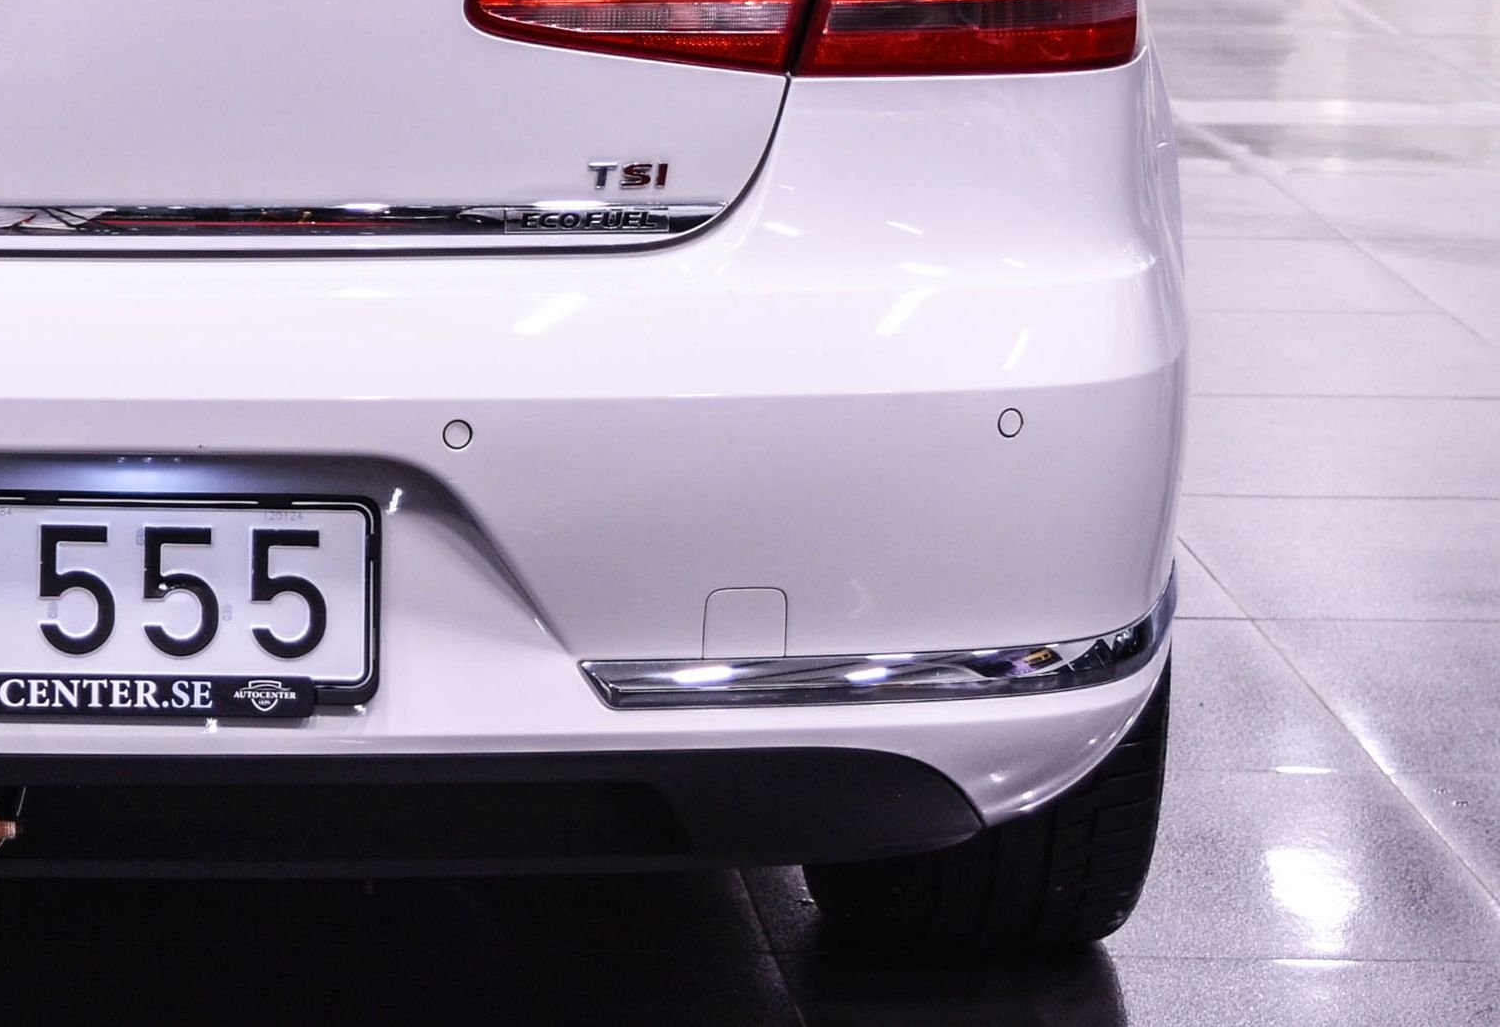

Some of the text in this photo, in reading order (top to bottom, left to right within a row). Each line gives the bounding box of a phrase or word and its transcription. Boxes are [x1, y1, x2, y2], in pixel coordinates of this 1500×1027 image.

[588, 162, 668, 189] TSI
[39, 523, 327, 660] 555
[233, 691, 296, 699] AUTOCENTER
